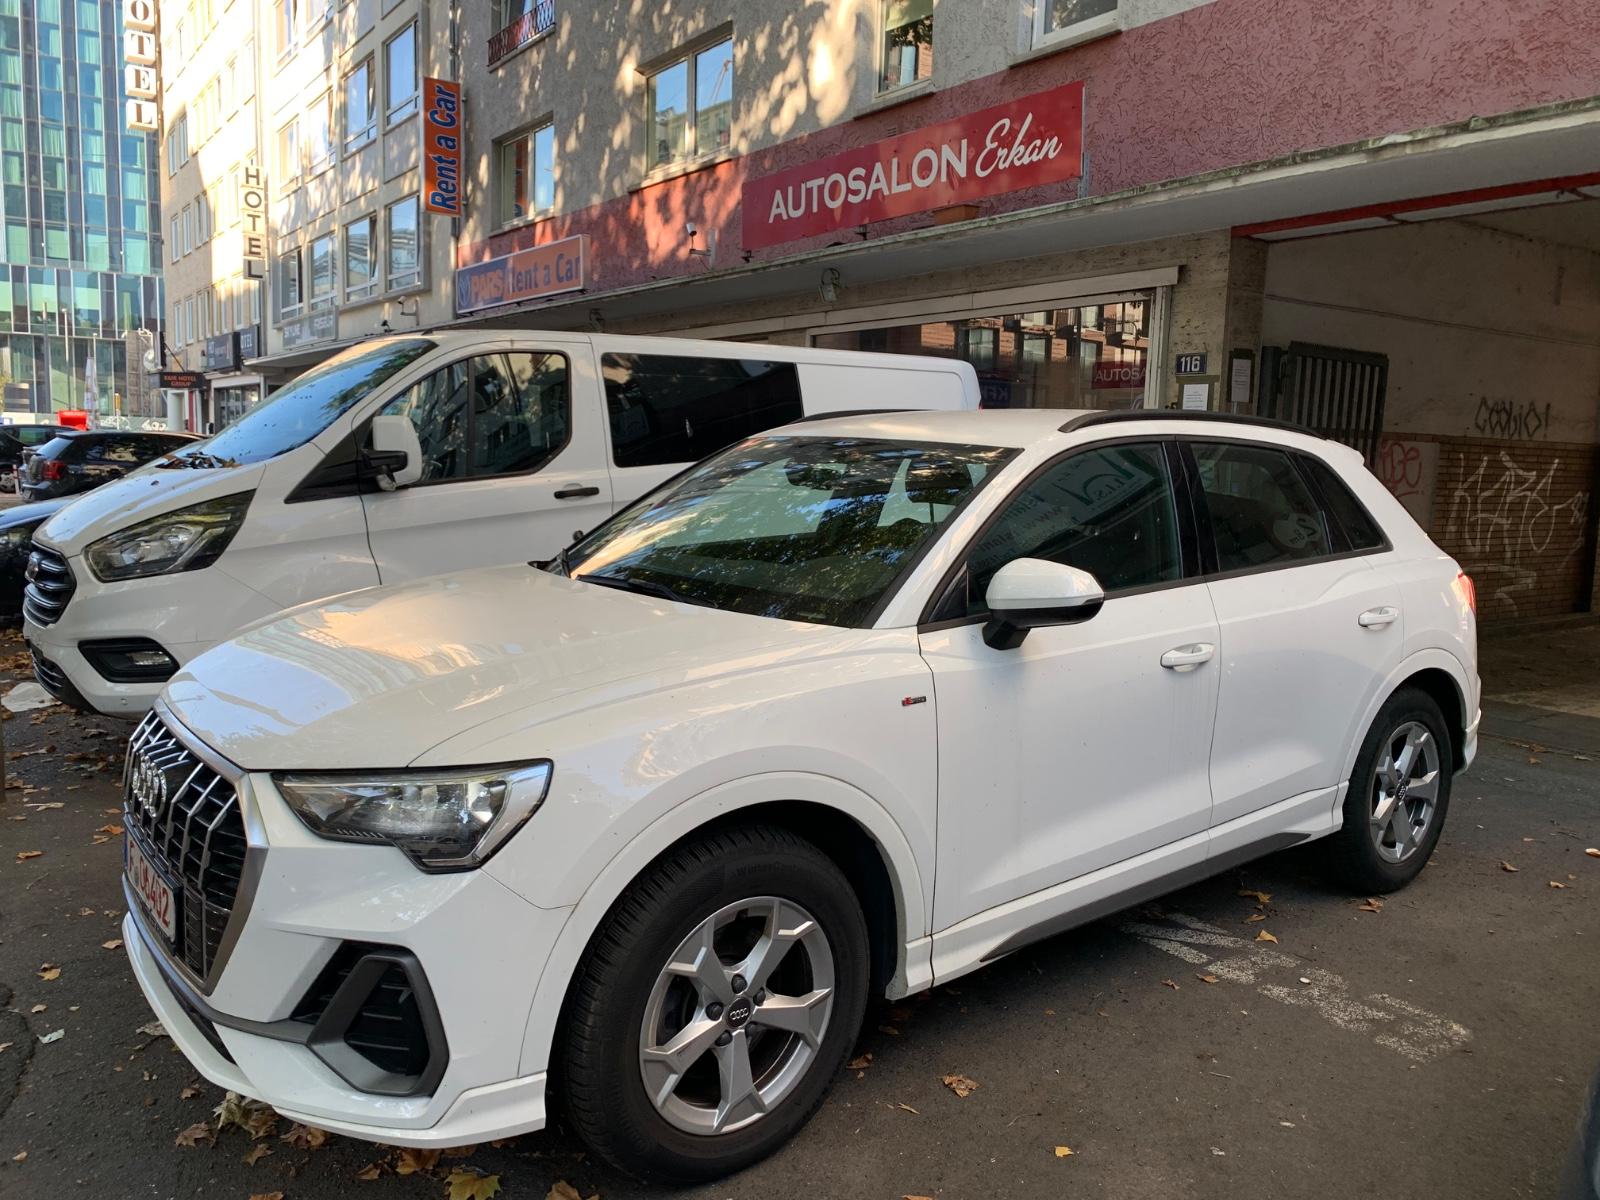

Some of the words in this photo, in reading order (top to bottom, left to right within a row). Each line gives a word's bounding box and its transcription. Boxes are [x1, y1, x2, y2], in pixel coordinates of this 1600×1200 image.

[428, 84, 457, 128] Car
[435, 135, 457, 151] a
[429, 154, 457, 211] Rent
[768, 138, 968, 224] AUTOSALON
[975, 112, 1063, 179] Erkan
[245, 166, 263, 279] HOTEL
[543, 264, 552, 287] a
[556, 253, 581, 283] Car
[1181, 356, 1201, 372] 116
